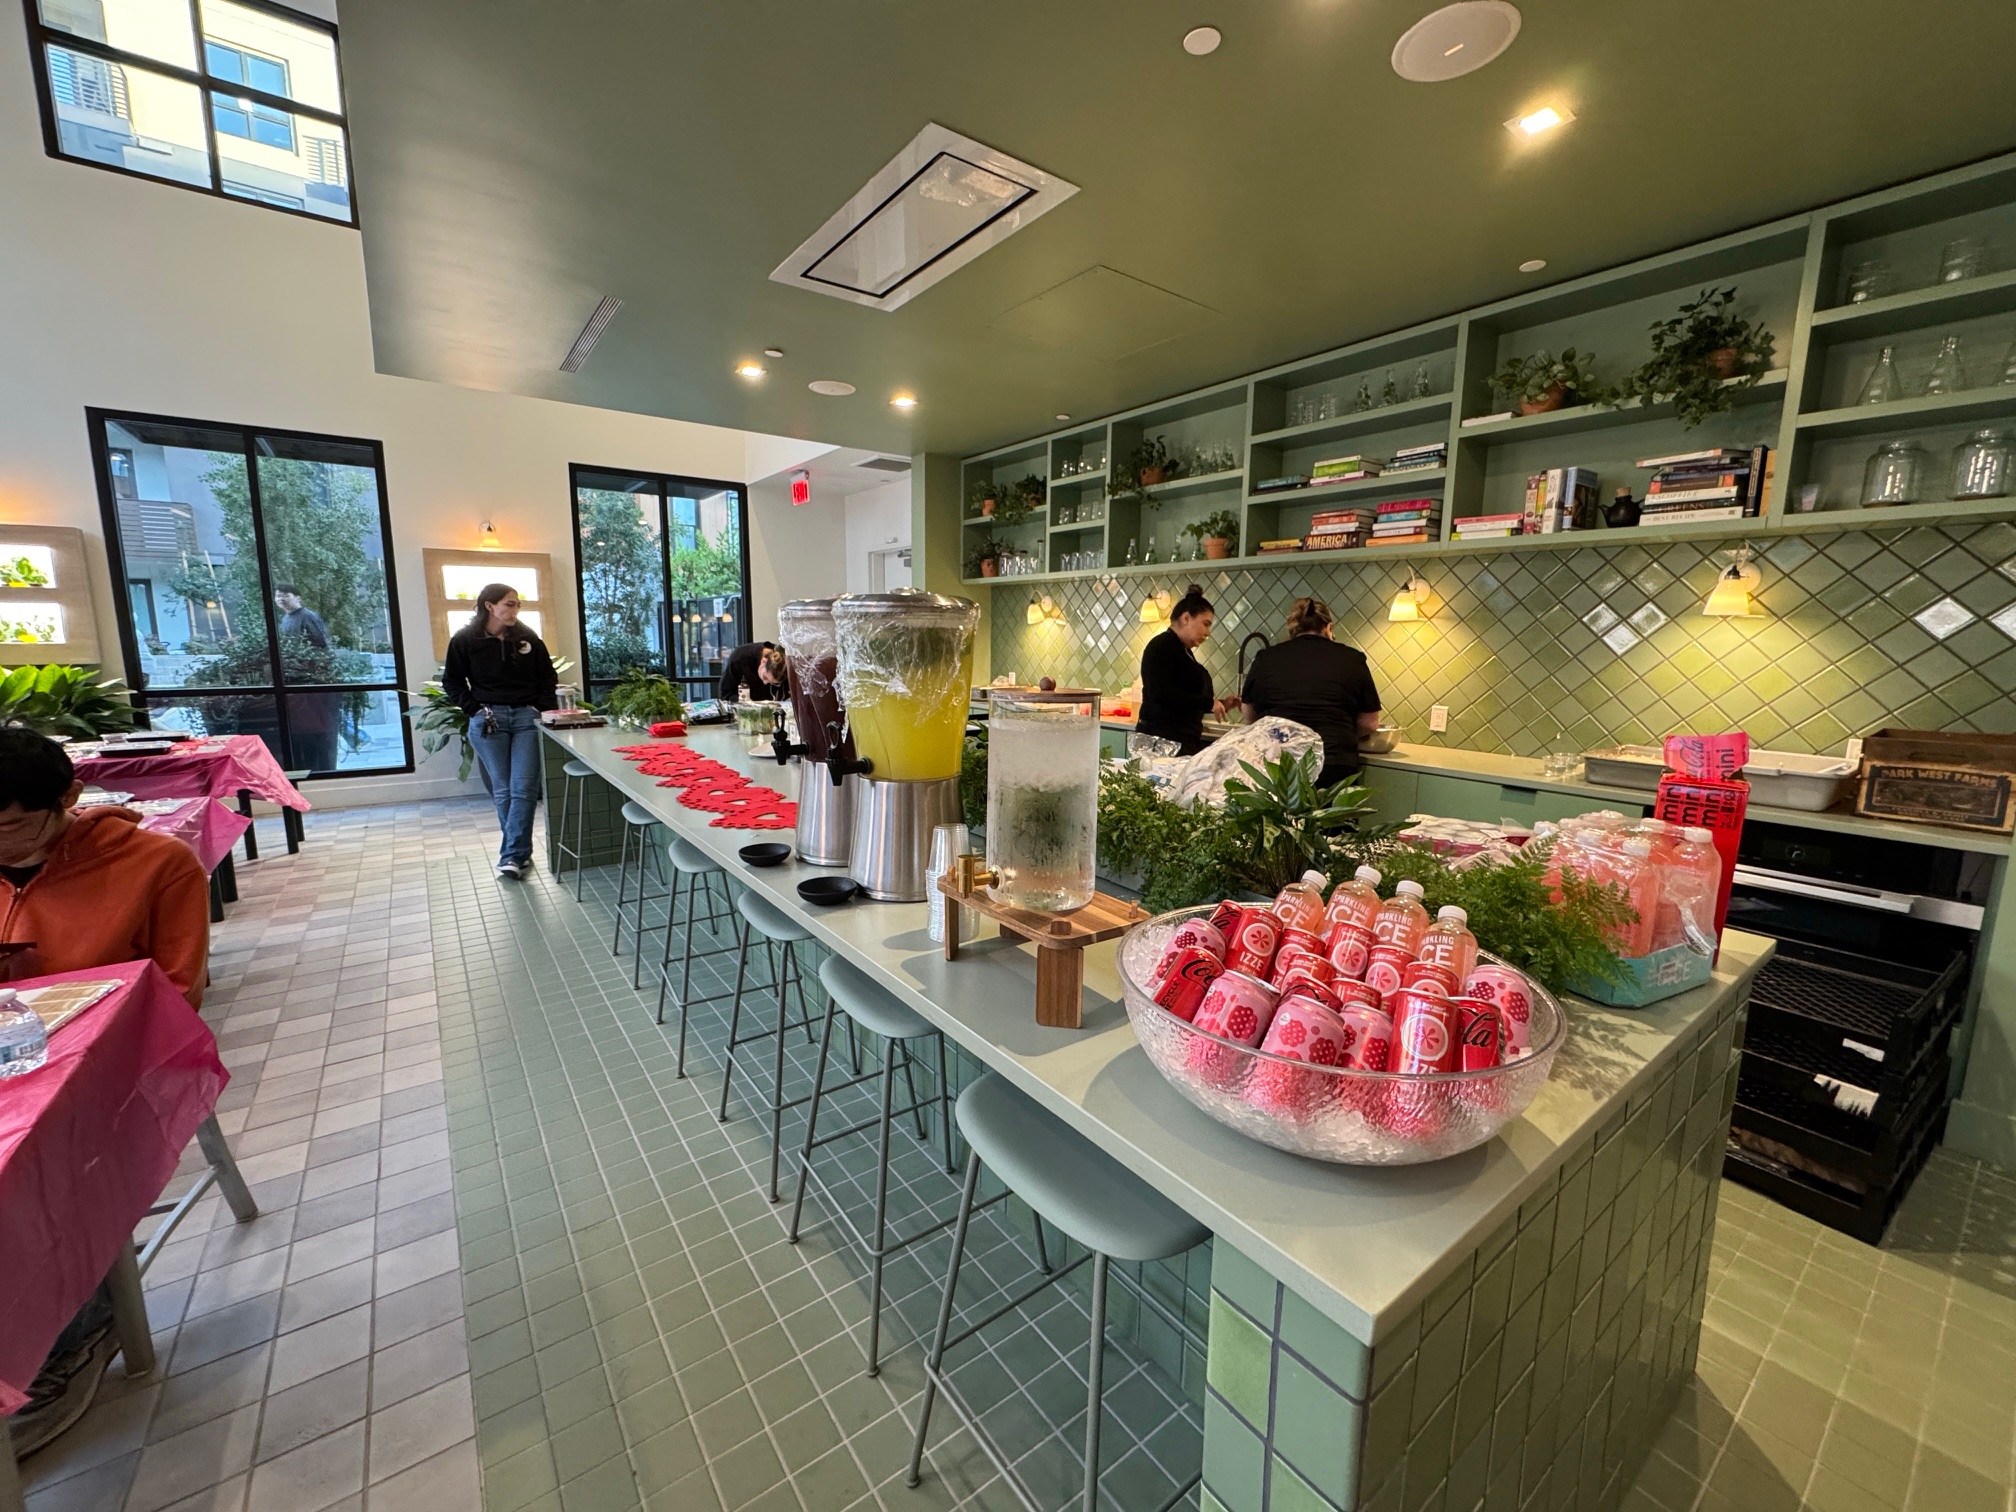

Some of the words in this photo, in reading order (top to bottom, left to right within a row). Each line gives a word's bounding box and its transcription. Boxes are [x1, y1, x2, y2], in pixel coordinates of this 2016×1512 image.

[1306, 533, 1348, 547] AMERICA
[1881, 769, 1914, 779] PARK
[1917, 770, 1951, 780] WEST
[1954, 773, 1998, 788] FARMS
[1271, 901, 1310, 927] ICE
[1279, 892, 1314, 915] SPARKLING
[1333, 894, 1370, 915] SPARKLING
[1239, 951, 1265, 972] IZZE
[1420, 944, 1454, 967] CE
[1271, 974, 1284, 988] IZ
[1159, 980, 1180, 1007] ECYCLE
